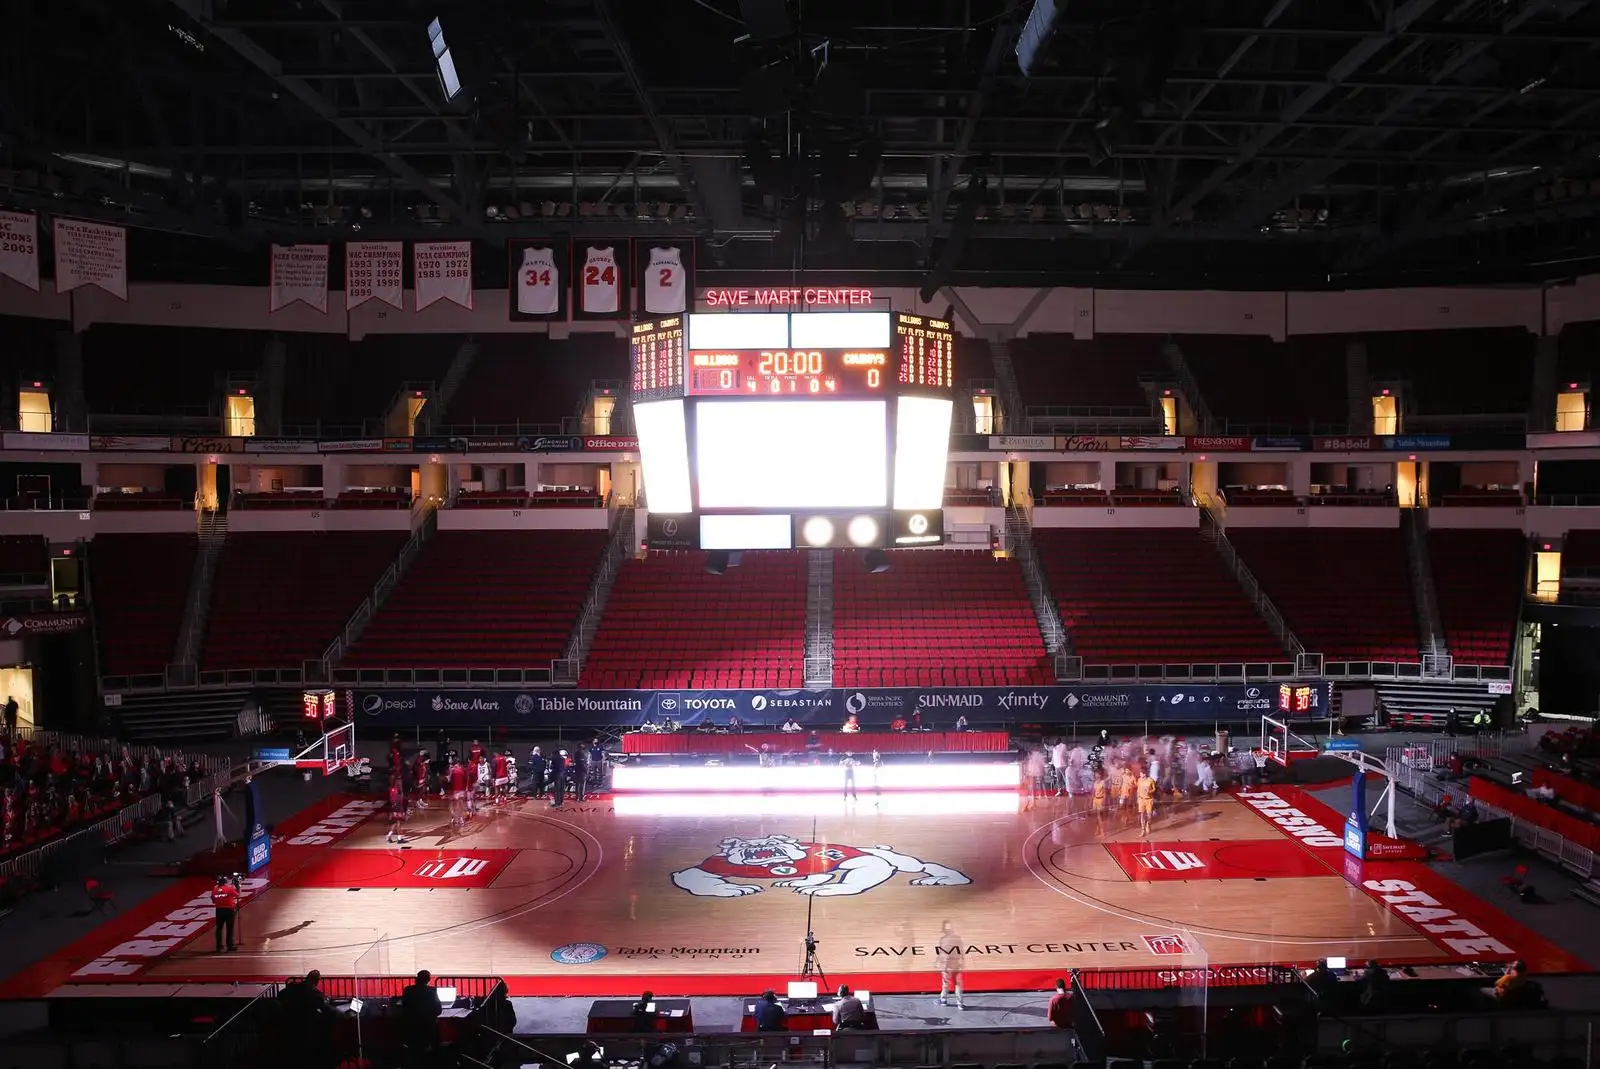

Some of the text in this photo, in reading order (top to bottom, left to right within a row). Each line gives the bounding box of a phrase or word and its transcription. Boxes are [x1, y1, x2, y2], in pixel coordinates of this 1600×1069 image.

[3, 242, 33, 254] 2003
[526, 270, 550, 286] 34
[586, 266, 615, 286] 24
[660, 269, 672, 287] 2
[707, 289, 872, 306] SAVE MART CENTER
[915, 329, 924, 337] PTS
[909, 336, 914, 345] 0
[919, 337, 924, 346] 0
[937, 340, 942, 349] 0
[947, 342, 952, 350] 0
[909, 346, 914, 354] 0
[919, 347, 924, 356] 0
[937, 350, 942, 358] 0
[947, 351, 952, 360] 0
[759, 352, 822, 374] 20:00
[909, 355, 914, 364] 0
[919, 356, 924, 365] 0
[928, 357, 952, 369] 22 0 0
[909, 364, 914, 373] 0
[919, 365, 924, 374] 0
[937, 368, 942, 376] 0
[947, 369, 952, 378] 0
[720, 370, 732, 388] 0
[868, 369, 879, 387] 0
[899, 372, 924, 384] 25 0 0
[928, 376, 952, 387] 25 0 0
[747, 380, 756, 392] 4
[771, 379, 780, 392] 0
[791, 380, 795, 392] 1
[810, 379, 819, 392] 0
[825, 380, 834, 391] 4
[587, 439, 616, 448] Office
[1065, 436, 1113, 451] Coors
[1324, 439, 1370, 449] #BeBold
[24, 617, 85, 628] COMMUNITY
[385, 698, 416, 710] pepsi
[444, 698, 500, 711] Save Mart
[538, 697, 641, 711] Table Mountain
[685, 699, 736, 709] TOYOTA
[998, 691, 1048, 710] xfinity
[1081, 694, 1130, 702] COMMUNITY
[1280, 694, 1289, 709] 30
[1296, 696, 1308, 710] 30
[305, 703, 316, 717] 30
[326, 702, 333, 716] 30
[286, 800, 388, 845] STATE
[1236, 791, 1345, 847] FRESNO
[1348, 830, 1360, 843] BUD
[253, 843, 266, 856] BUD
[1346, 838, 1361, 852] LIGHT
[251, 849, 268, 865] LIGHT
[1362, 879, 1516, 955] STATE
[70, 877, 270, 976] FRESNO
[855, 942, 1139, 956] SAVE MART CENTER
